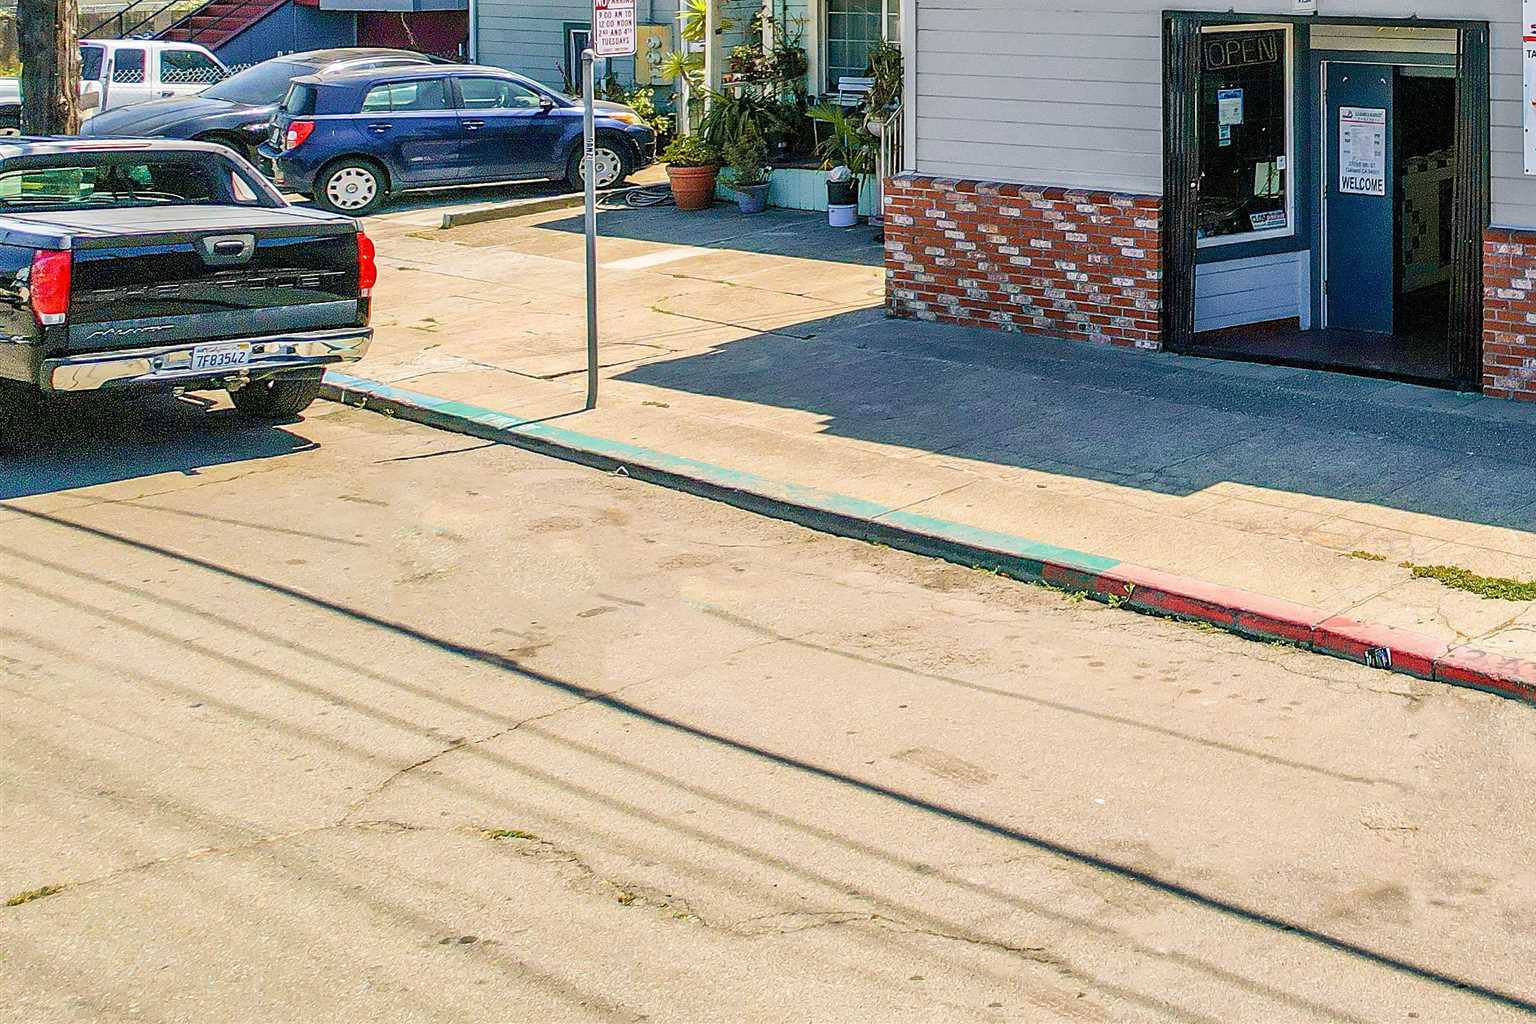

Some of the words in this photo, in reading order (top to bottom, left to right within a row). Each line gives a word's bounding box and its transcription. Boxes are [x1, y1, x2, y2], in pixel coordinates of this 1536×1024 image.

[625, 10, 632, 18] TO
[602, 37, 630, 46] TUESDAYS
[1208, 35, 1276, 66] OPEN
[1341, 175, 1383, 192] WELCOME
[196, 352, 246, 368] 7F83542
